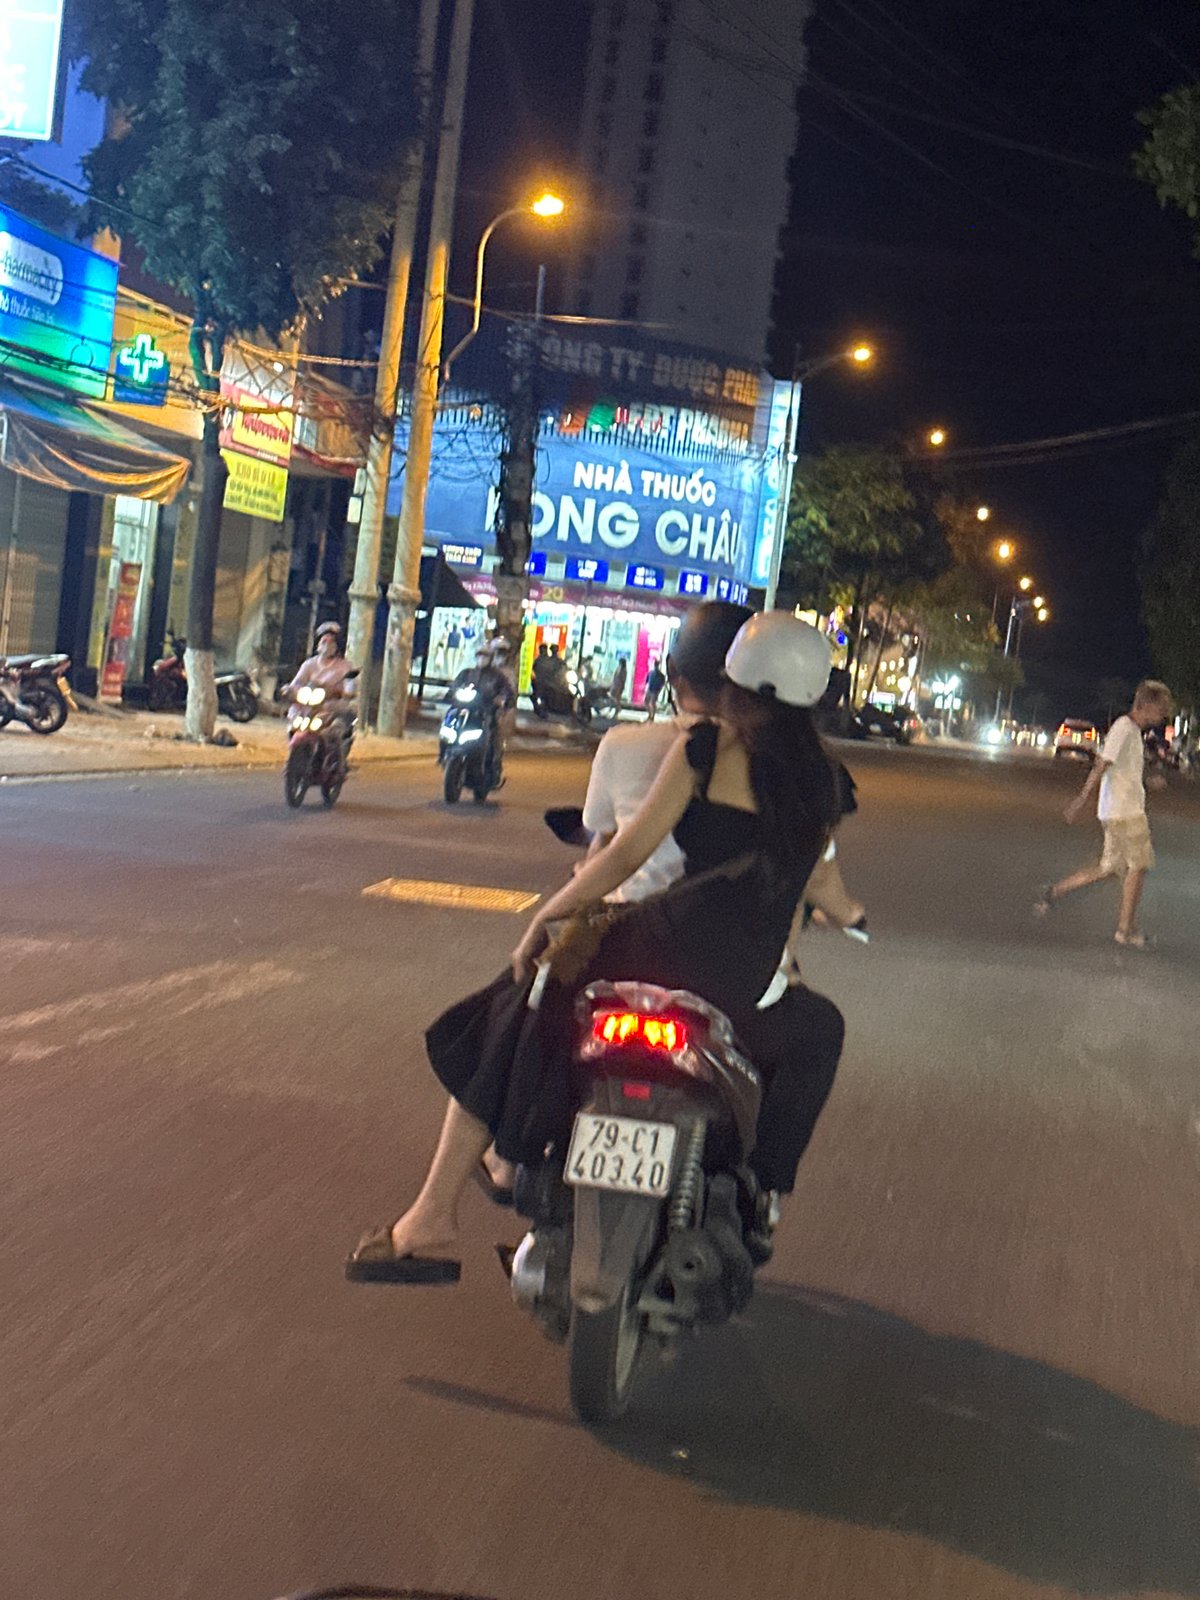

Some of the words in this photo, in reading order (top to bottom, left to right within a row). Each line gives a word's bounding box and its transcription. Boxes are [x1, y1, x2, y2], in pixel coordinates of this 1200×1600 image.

[573, 459, 633, 495] NHÀ
[641, 468, 717, 507] THUỐC
[655, 508, 742, 566] CHÂU
[589, 1119, 660, 1157] 79-C1
[573, 1150, 665, 1188] 403.40
